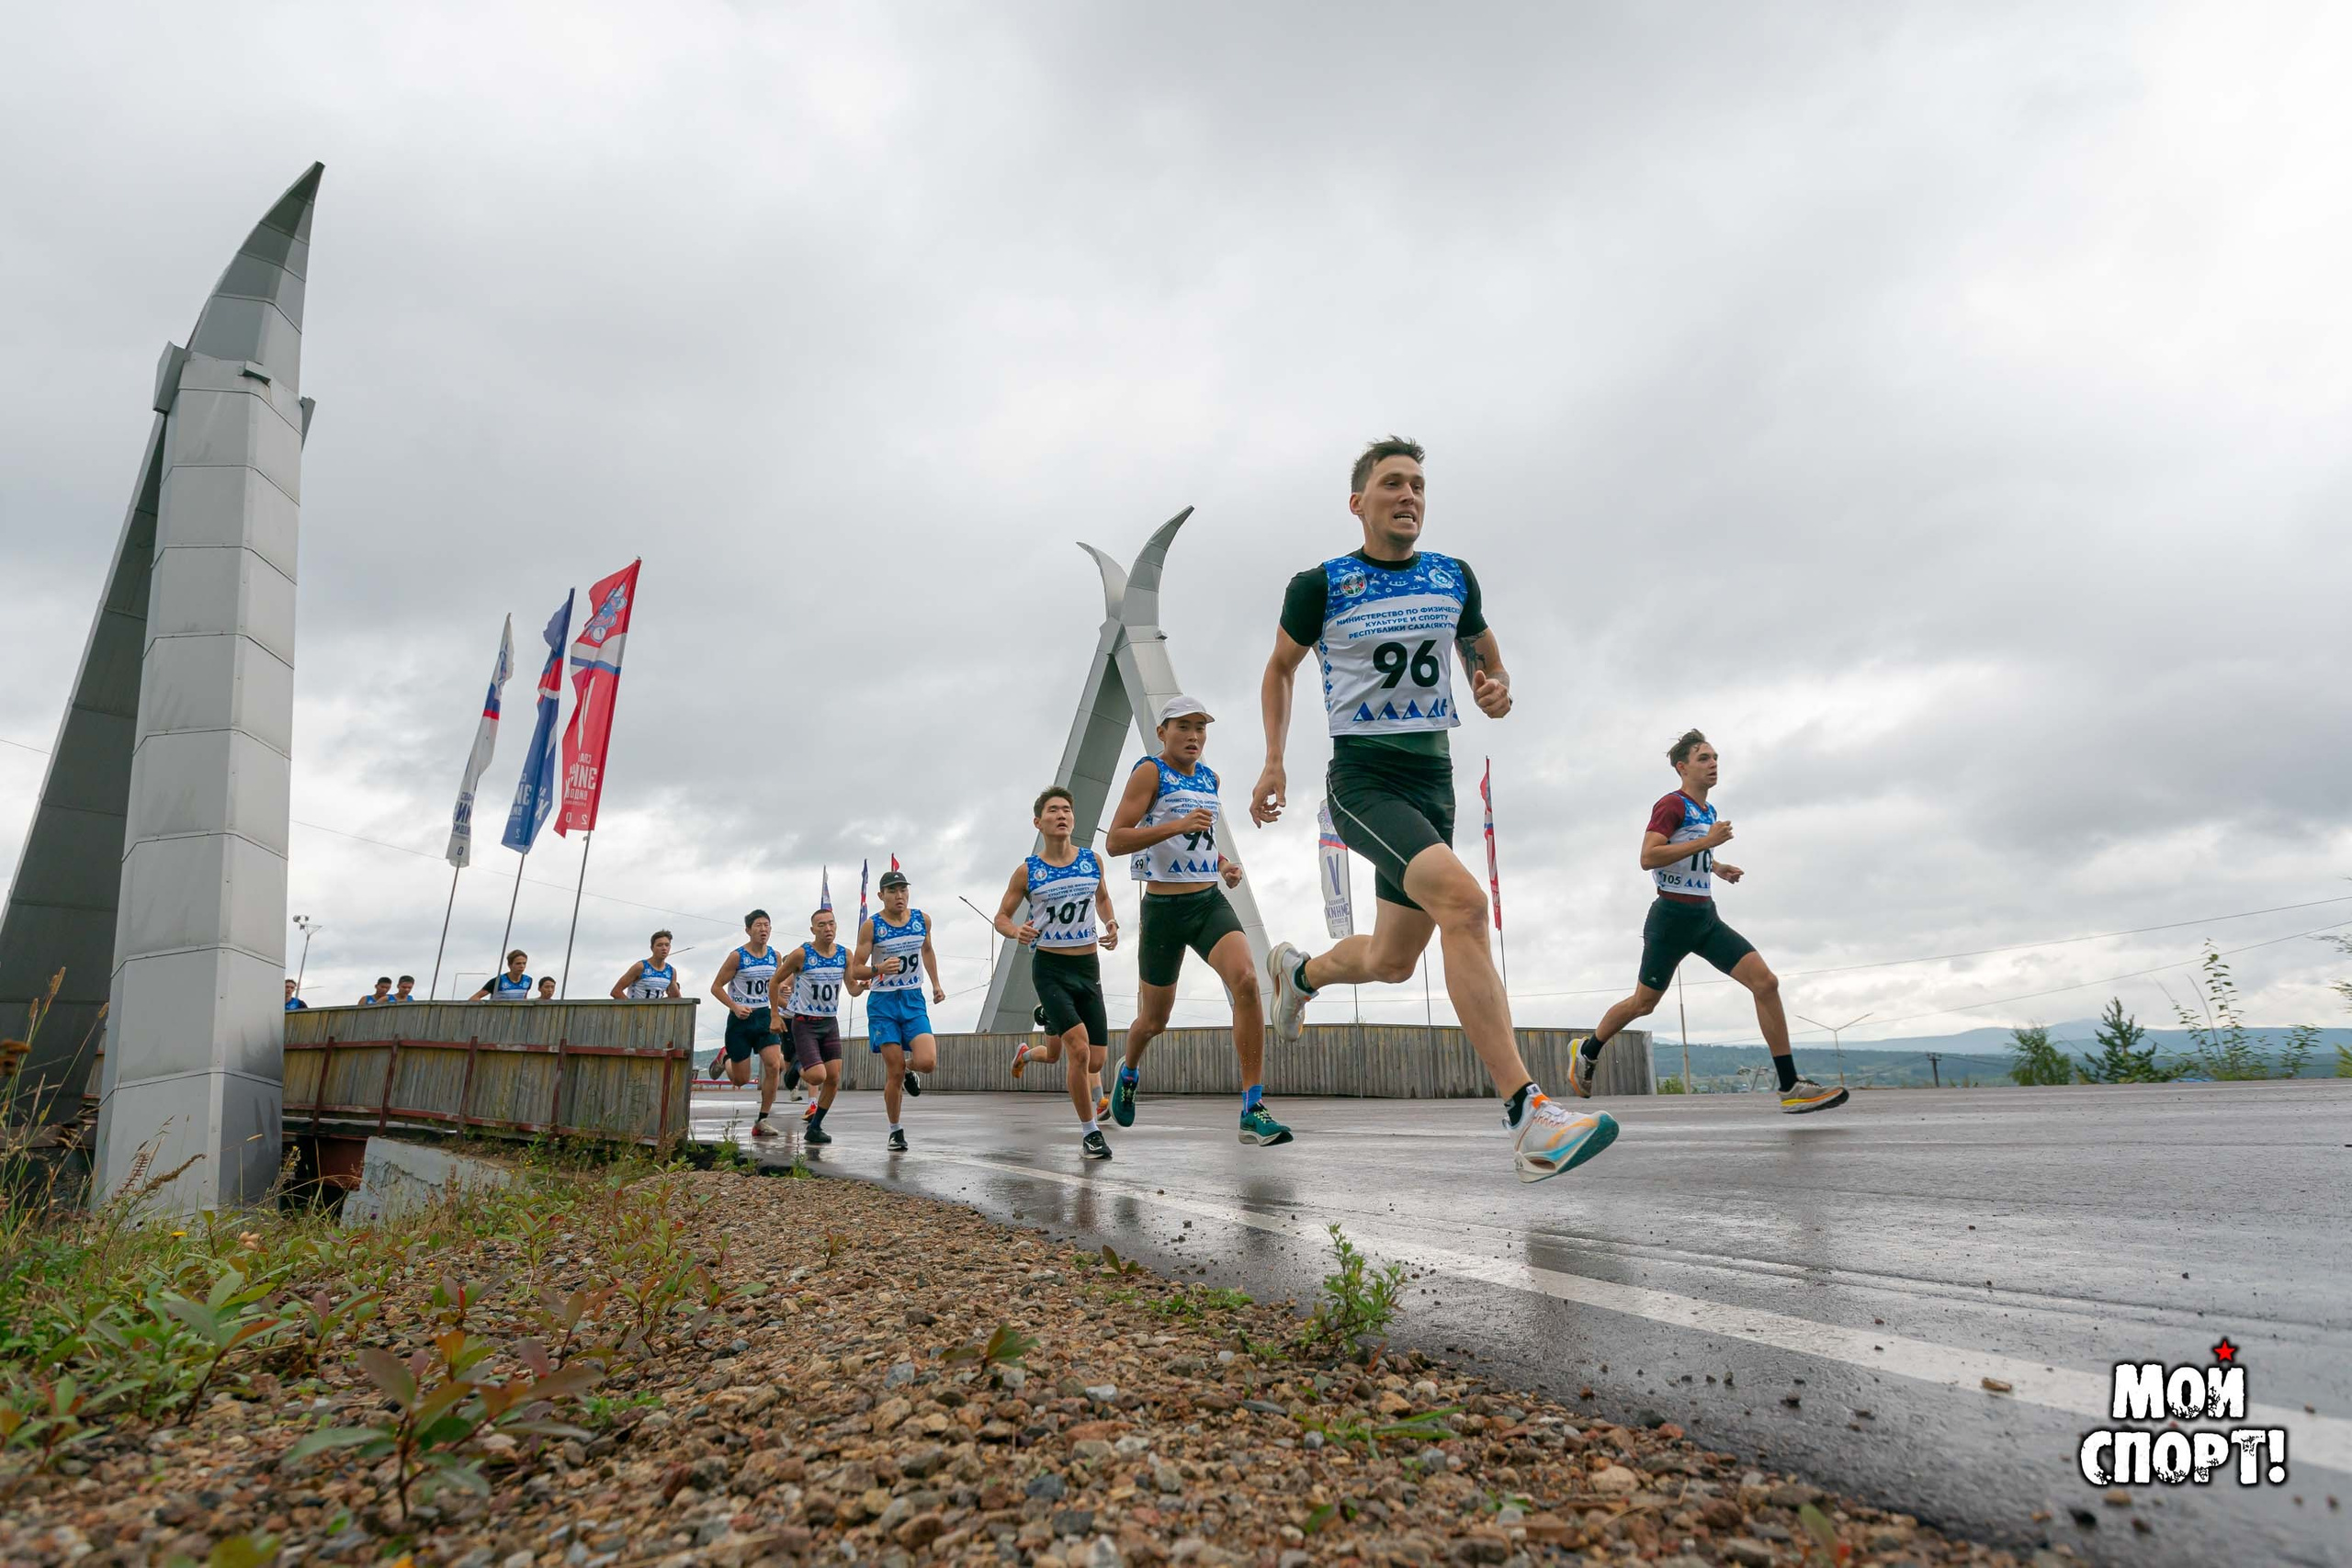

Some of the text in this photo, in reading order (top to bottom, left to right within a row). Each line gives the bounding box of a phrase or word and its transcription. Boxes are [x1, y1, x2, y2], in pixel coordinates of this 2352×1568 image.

[1336, 610, 1404, 626] МИНИСТЕРСТВО
[1365, 617, 1408, 628] КУЛЬТУРЕ
[1418, 614, 1449, 622] СПОРТУ
[1348, 625, 1406, 639] РЕСПУБЛИКИ
[1373, 639, 1440, 689] 96
[1690, 848, 1713, 874] 10
[1663, 874, 1681, 886] 105
[1046, 897, 1091, 925] 107
[884, 953, 919, 975] 09
[811, 984, 840, 1002] 101
